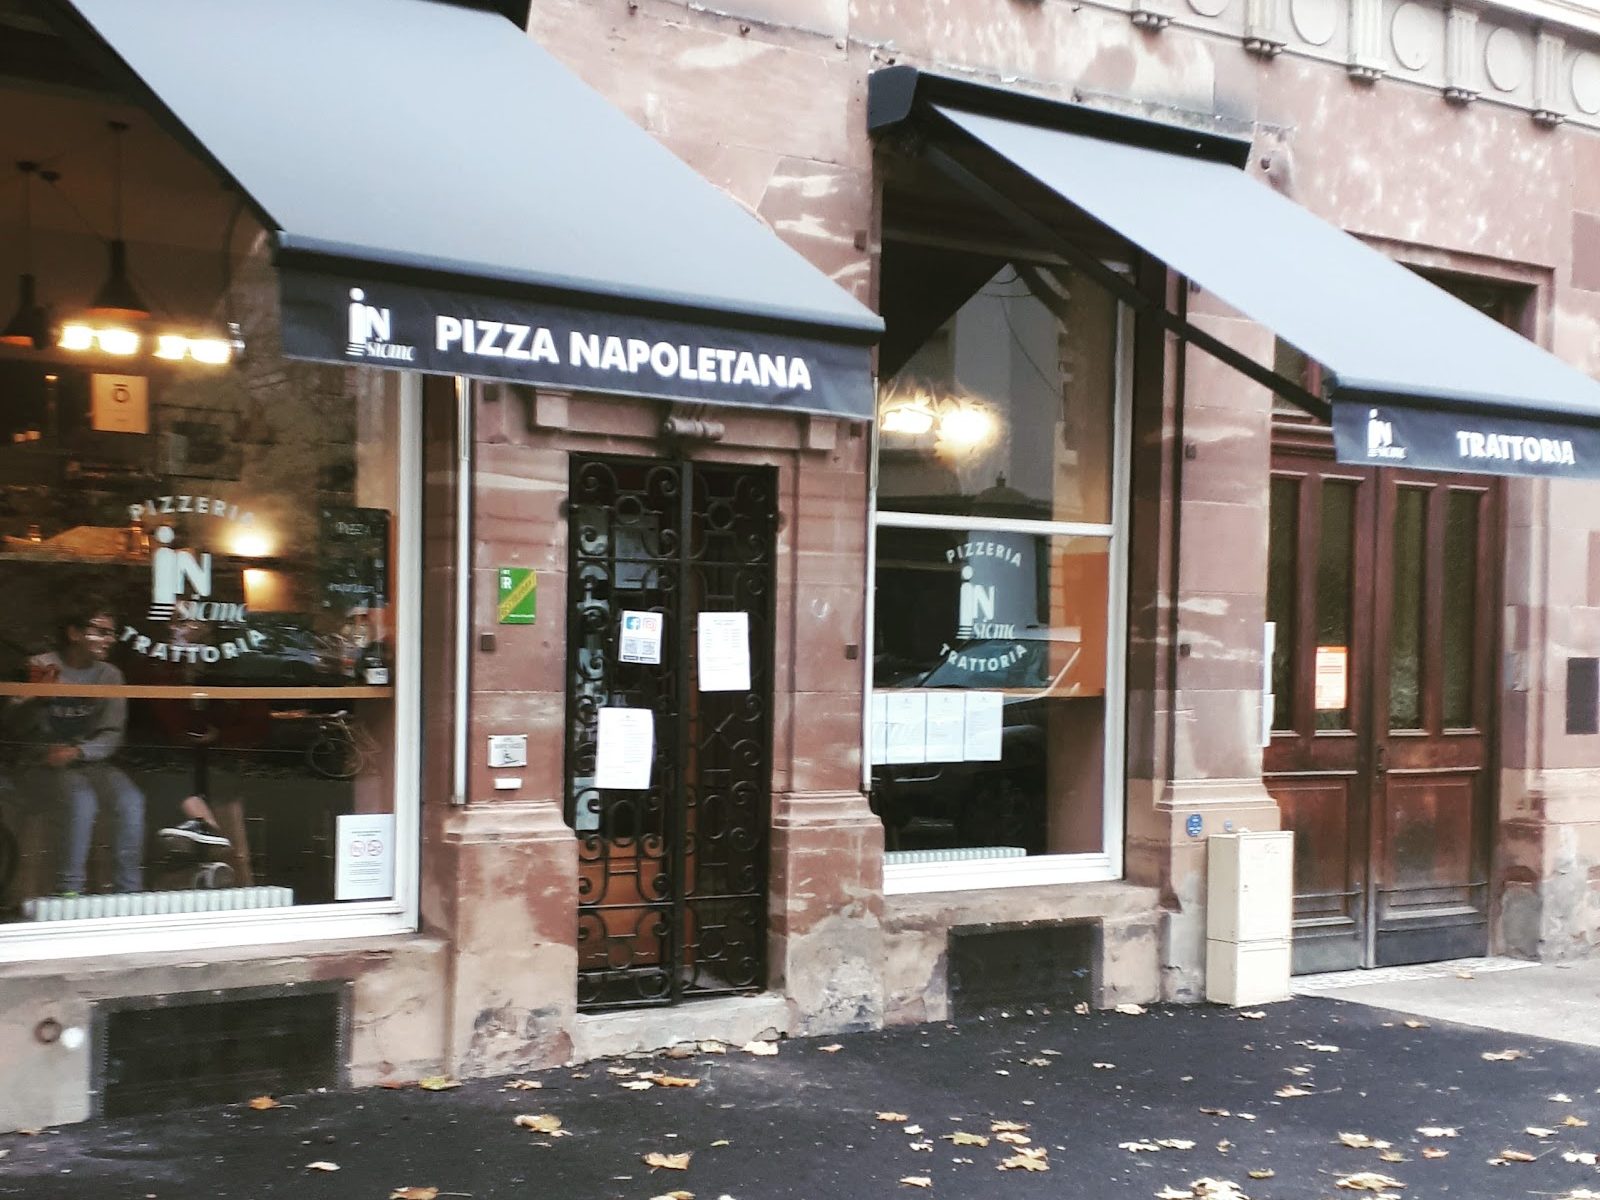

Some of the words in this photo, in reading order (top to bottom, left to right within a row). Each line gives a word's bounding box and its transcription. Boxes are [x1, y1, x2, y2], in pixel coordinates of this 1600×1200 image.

[435, 315, 560, 364] PIZZA
[569, 331, 812, 391] NAPOLETANA
[1456, 430, 1576, 465] TRATTORIA
[128, 495, 255, 525] PIZZERIA
[946, 542, 1022, 567] PIZZERIA
[119, 625, 267, 664] TRATTORIA
[940, 643, 1027, 672] TRATTORIA
